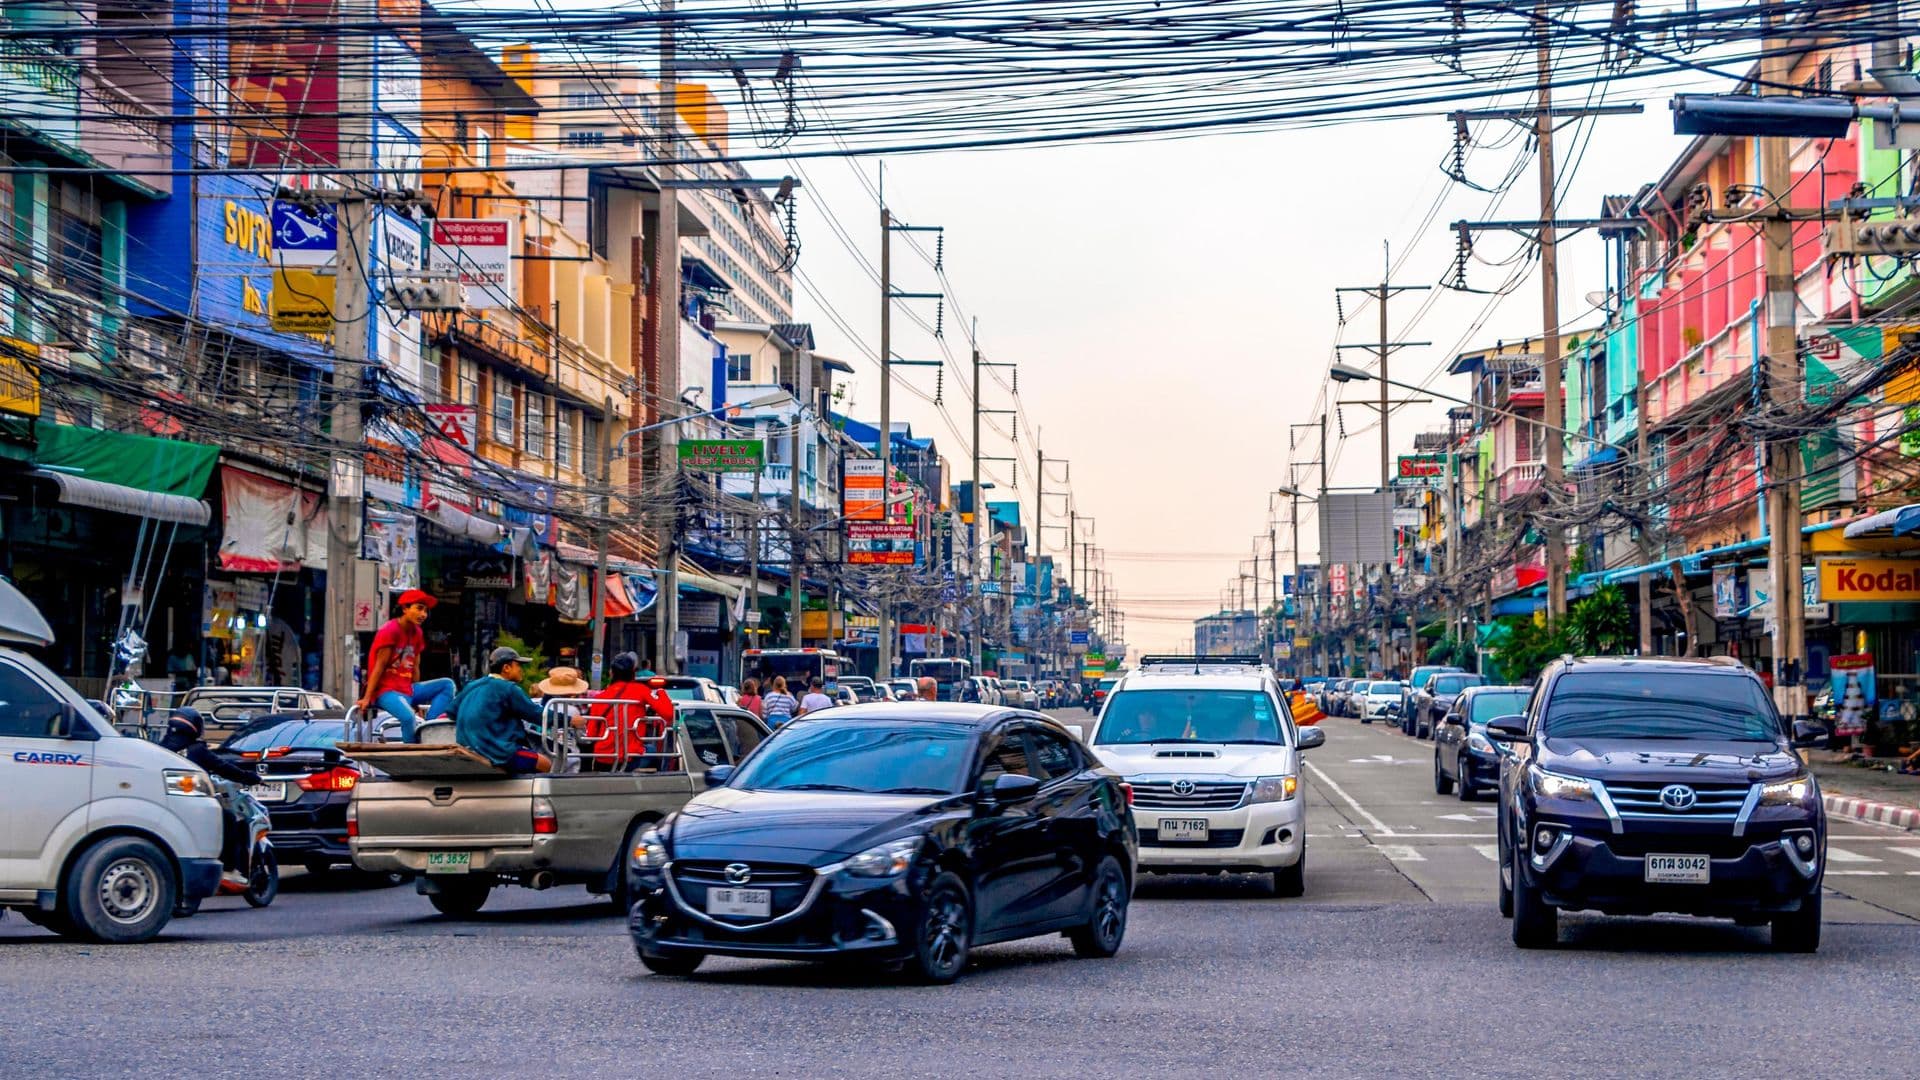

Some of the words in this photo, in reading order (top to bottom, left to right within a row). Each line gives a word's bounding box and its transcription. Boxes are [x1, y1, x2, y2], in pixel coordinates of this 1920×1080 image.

[693, 446, 748, 455] LIVELY
[682, 457, 717, 465] GUEST
[464, 575, 512, 587] makita
[13, 751, 82, 764] CARRY
[1182, 821, 1205, 831] 7162
[1677, 858, 1706, 870] 3042
